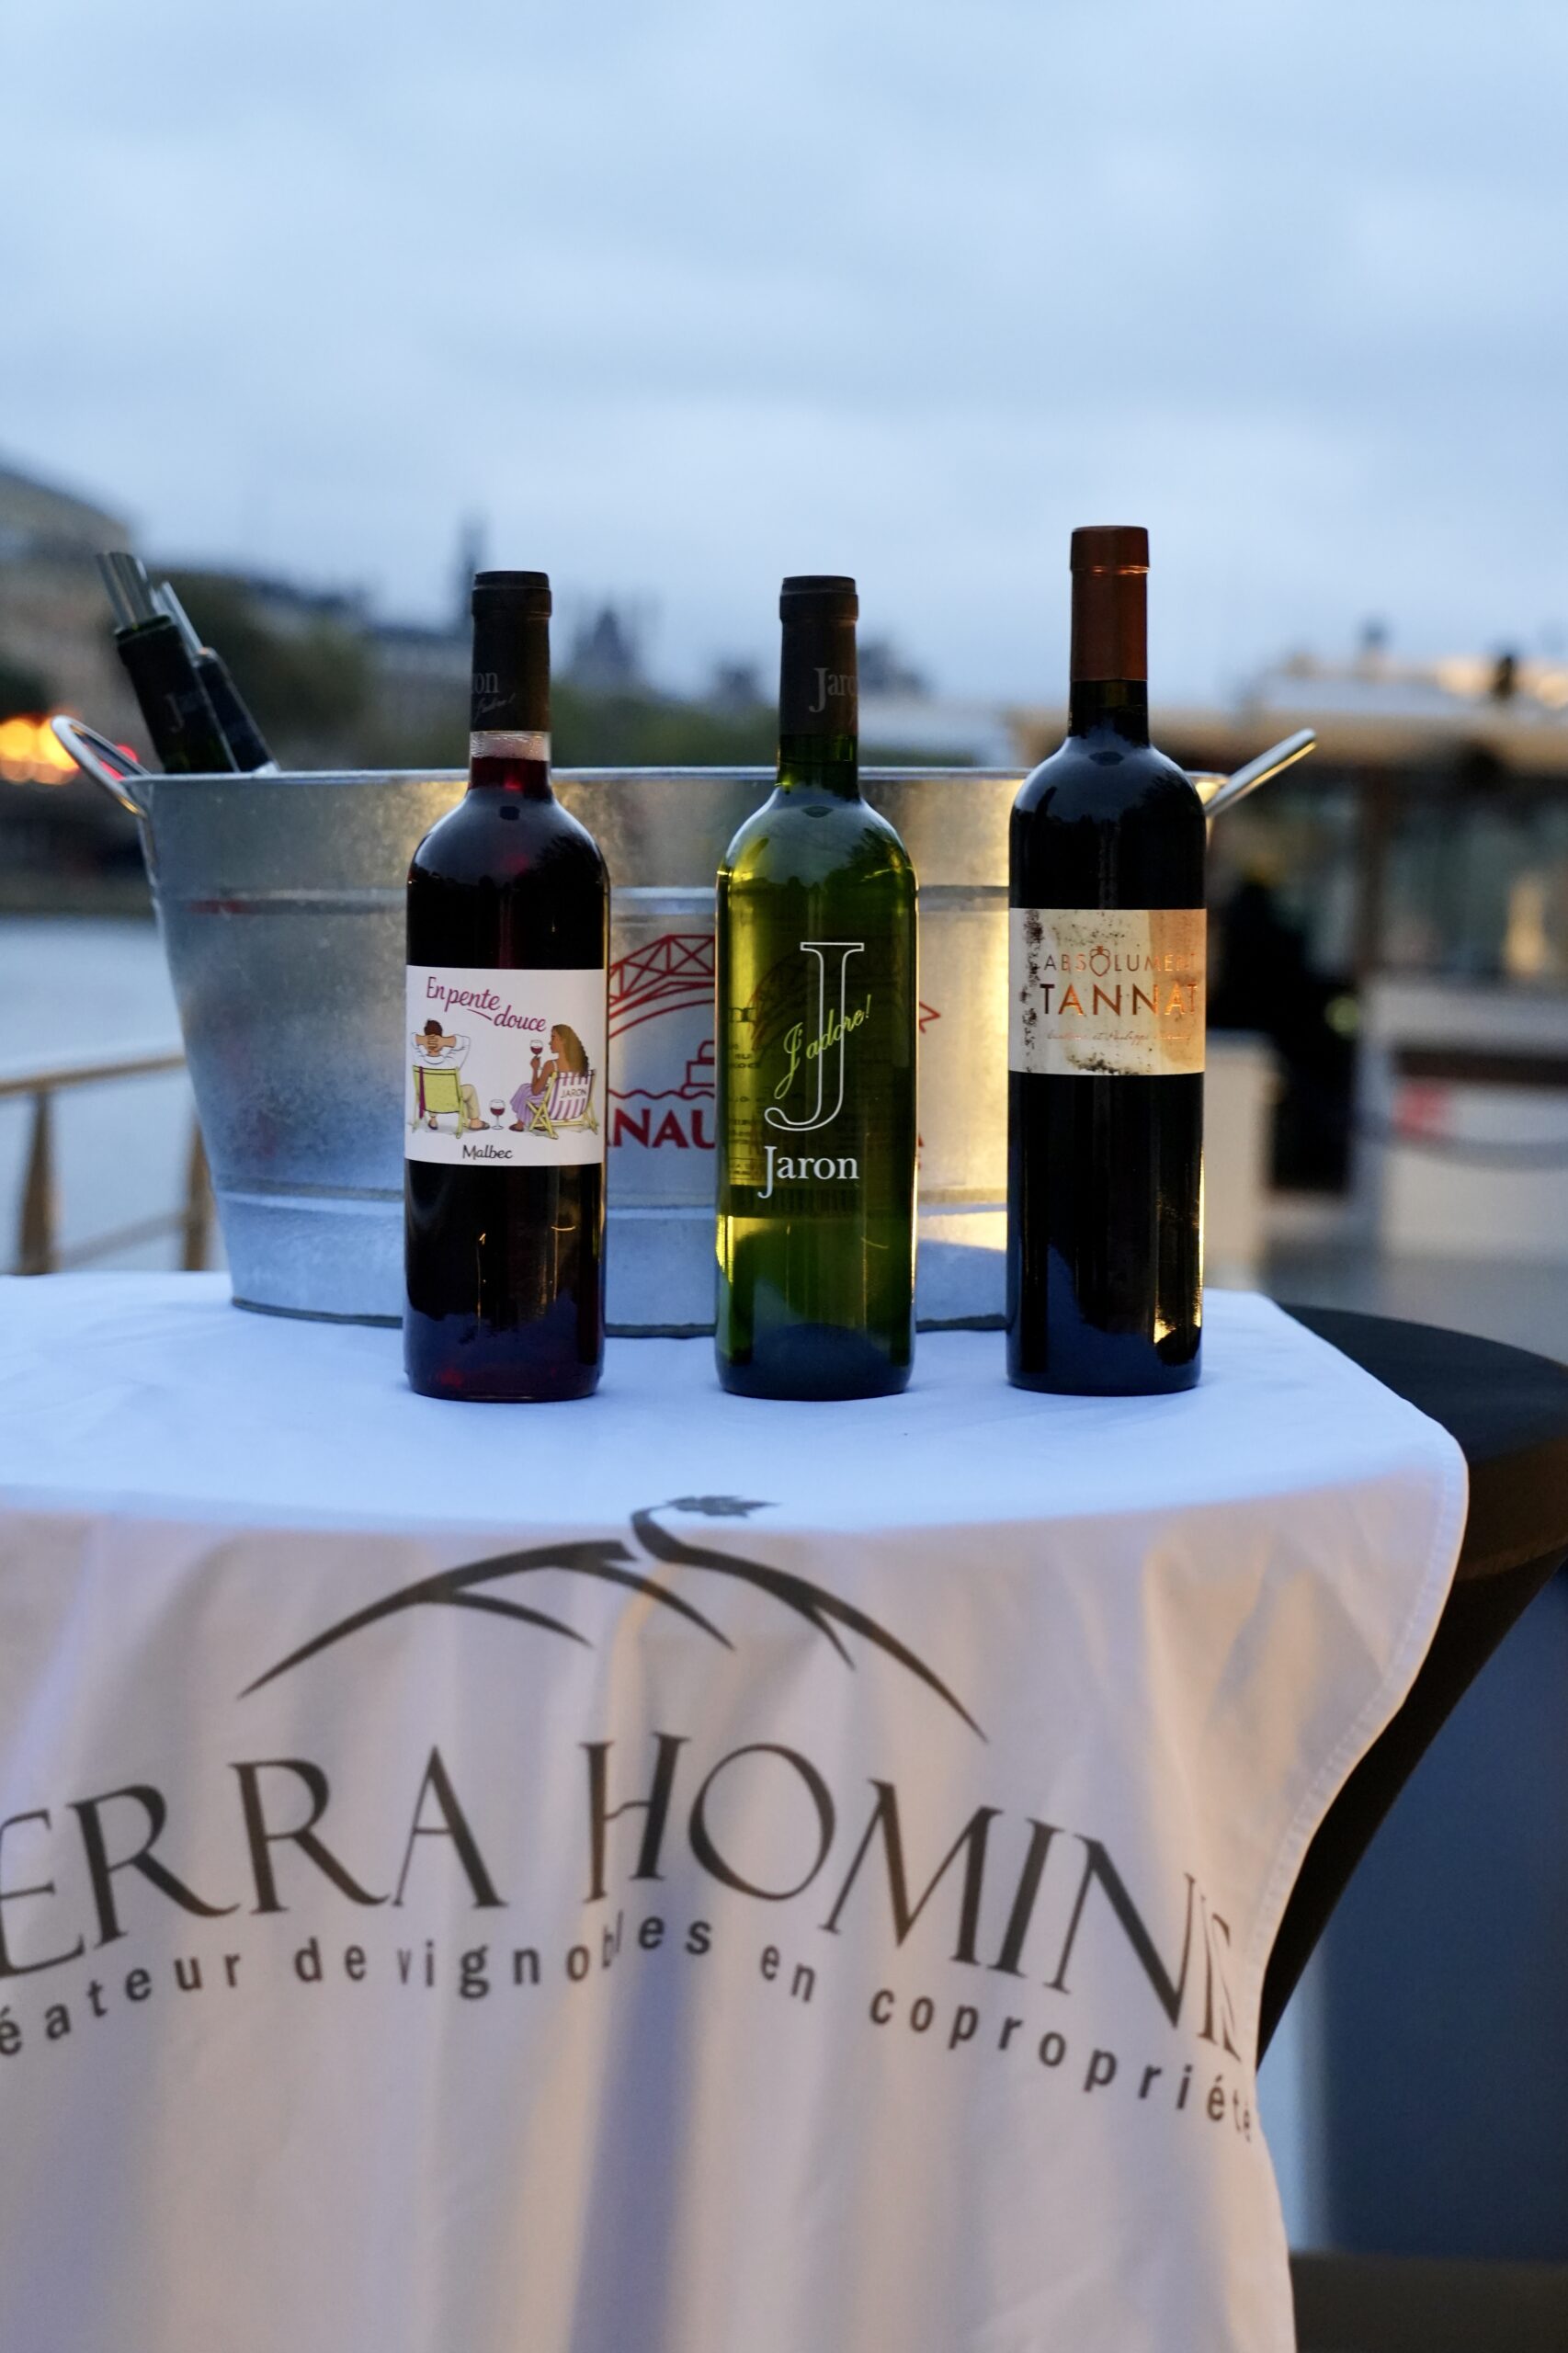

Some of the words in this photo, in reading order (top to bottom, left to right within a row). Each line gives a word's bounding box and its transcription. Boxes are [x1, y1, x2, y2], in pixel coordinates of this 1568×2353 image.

[426, 977, 445, 1000] En
[444, 989, 501, 1012] pente
[1040, 983, 1199, 1017] TANNAT
[493, 1005, 547, 1032] douce
[765, 942, 865, 1131] J
[774, 994, 872, 1099] J'adore!
[560, 1088, 586, 1098] JARON
[462, 1144, 513, 1160] Malbec
[757, 1145, 859, 1199] Jaron
[294, 1937, 367, 1982] de
[759, 1942, 816, 2004] en
